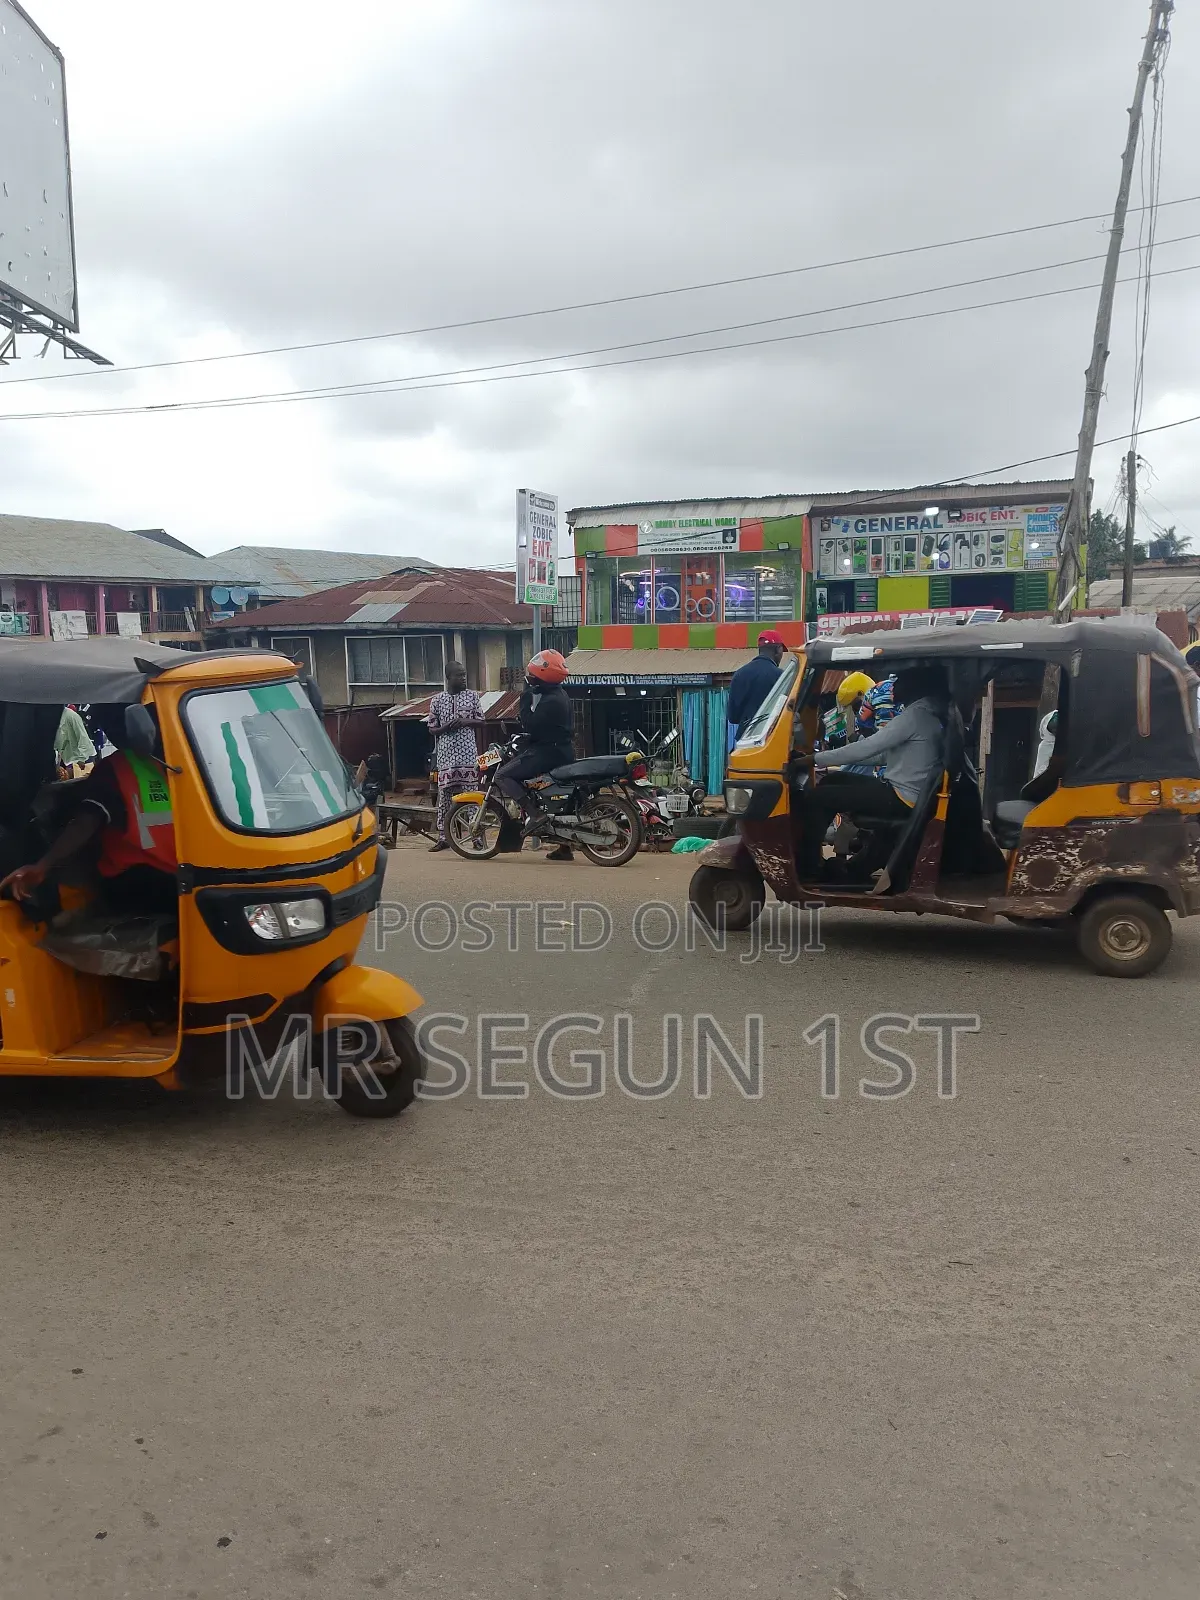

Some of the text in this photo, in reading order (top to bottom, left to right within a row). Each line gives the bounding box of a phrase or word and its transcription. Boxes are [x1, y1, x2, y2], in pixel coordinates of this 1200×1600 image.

[530, 511, 556, 528] GENERAL
[679, 518, 712, 527] ELECTRICAL
[715, 517, 737, 526] WORKS
[854, 515, 943, 533] GENERAL
[948, 511, 987, 523] OBIC
[991, 510, 1019, 520] ENT.
[532, 526, 552, 541] ZOBIC
[532, 539, 552, 560] ENT.
[560, 676, 585, 684] OWDY
[588, 675, 635, 684] ELECTRICAL
